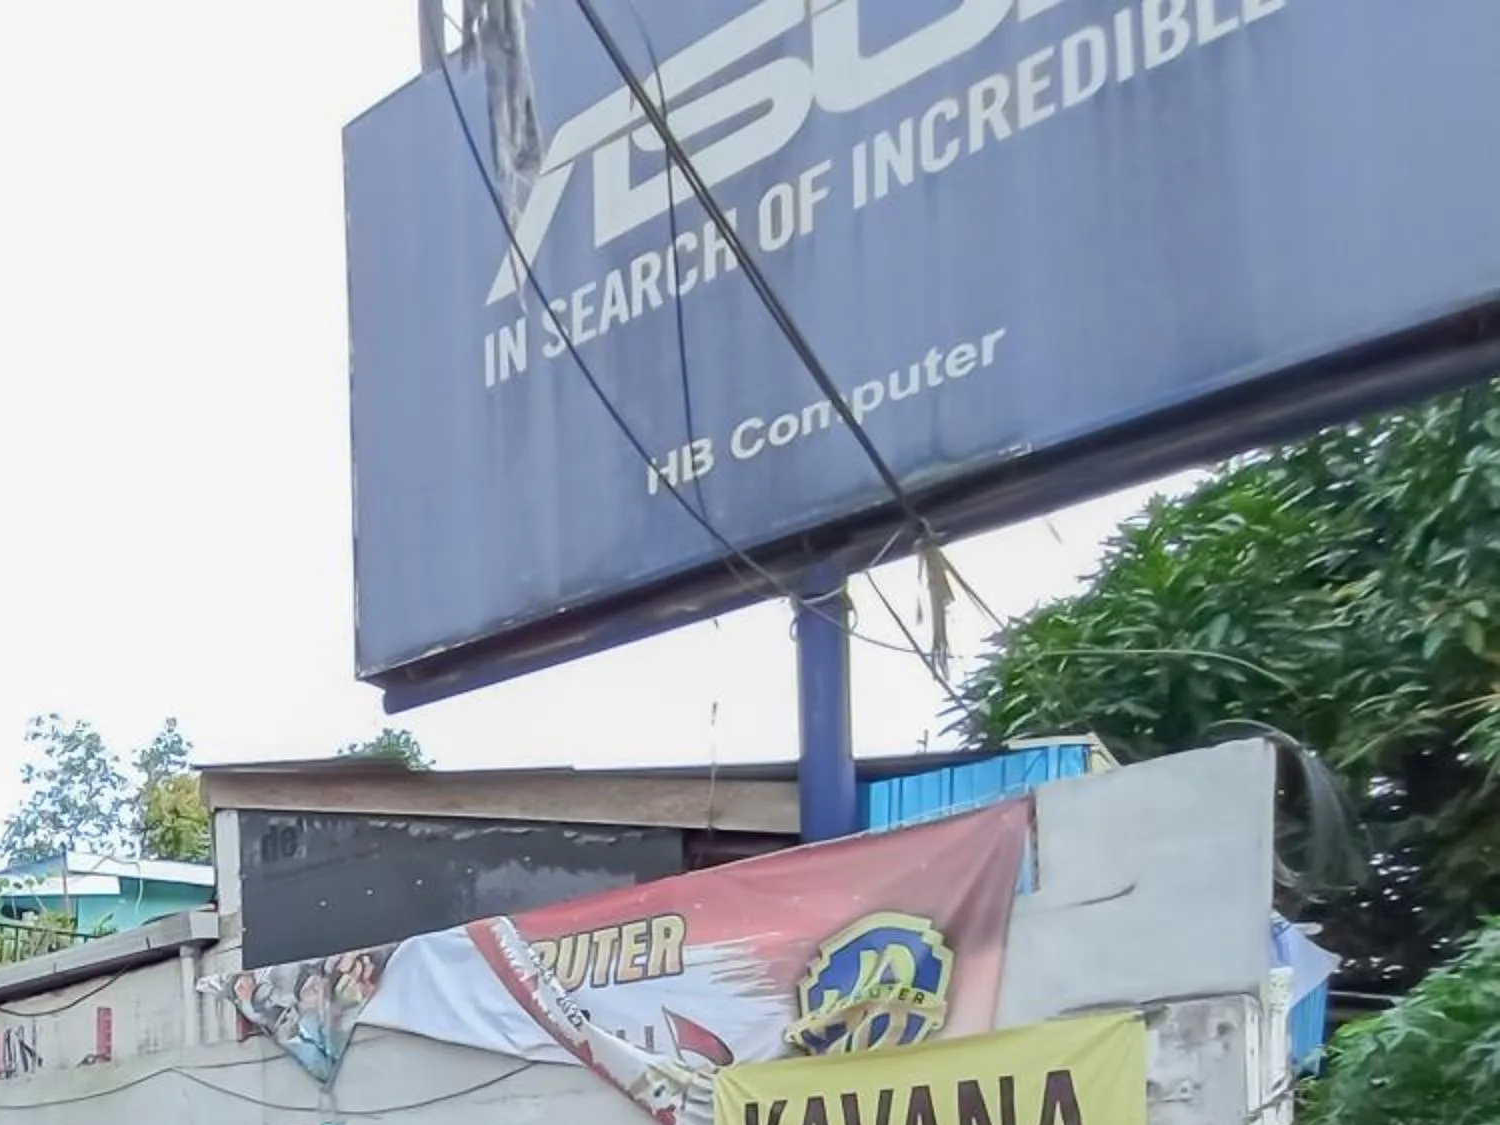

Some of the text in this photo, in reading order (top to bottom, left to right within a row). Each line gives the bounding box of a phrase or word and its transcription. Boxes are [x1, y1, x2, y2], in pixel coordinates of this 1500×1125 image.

[484, 0, 1287, 388] IN SEARCH OF INCREDIBL
[730, 327, 1006, 461] Computer
